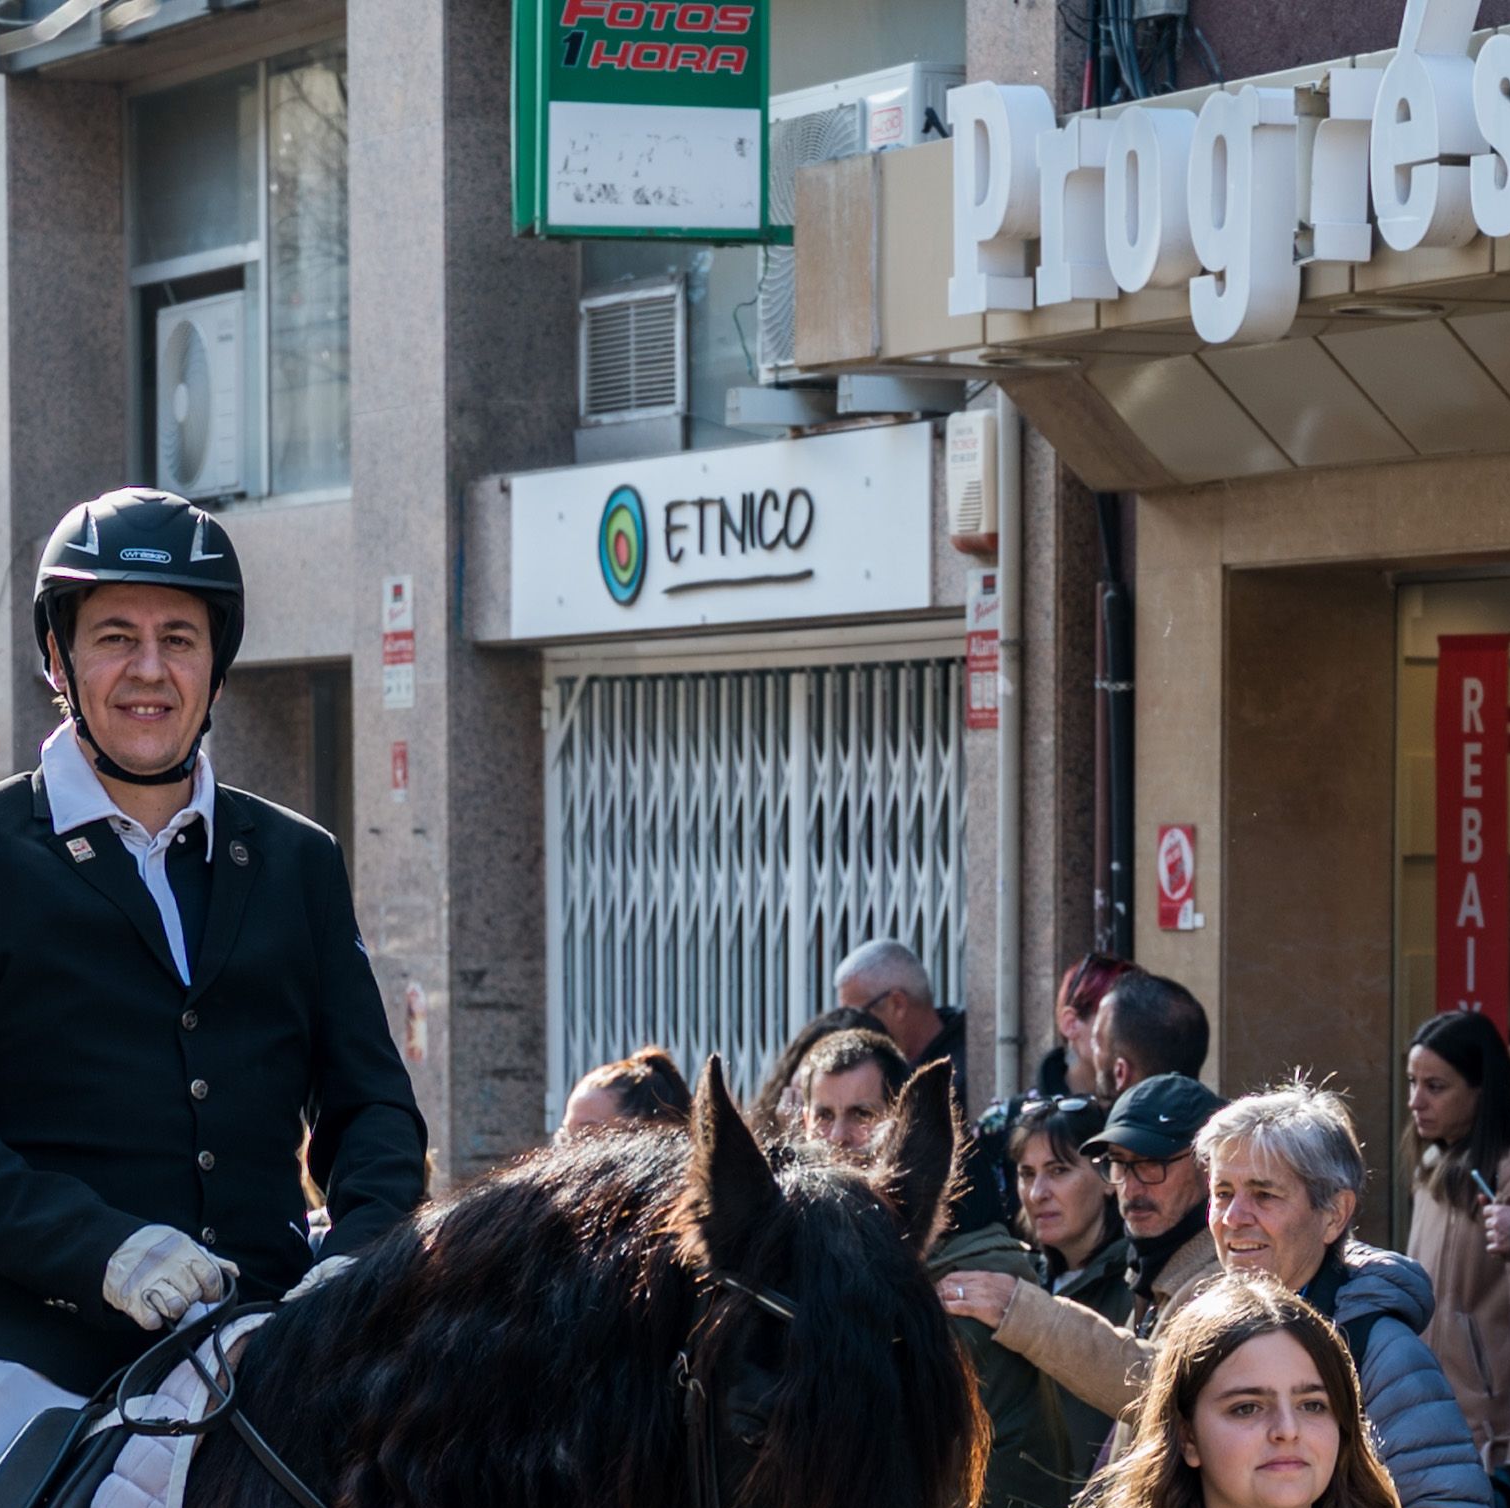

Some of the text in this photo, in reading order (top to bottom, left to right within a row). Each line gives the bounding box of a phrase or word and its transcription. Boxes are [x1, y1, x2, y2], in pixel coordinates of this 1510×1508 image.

[560, 0, 754, 34] FOTOS
[561, 30, 748, 74] 1 HORA
[664, 487, 815, 563] ETNICO
